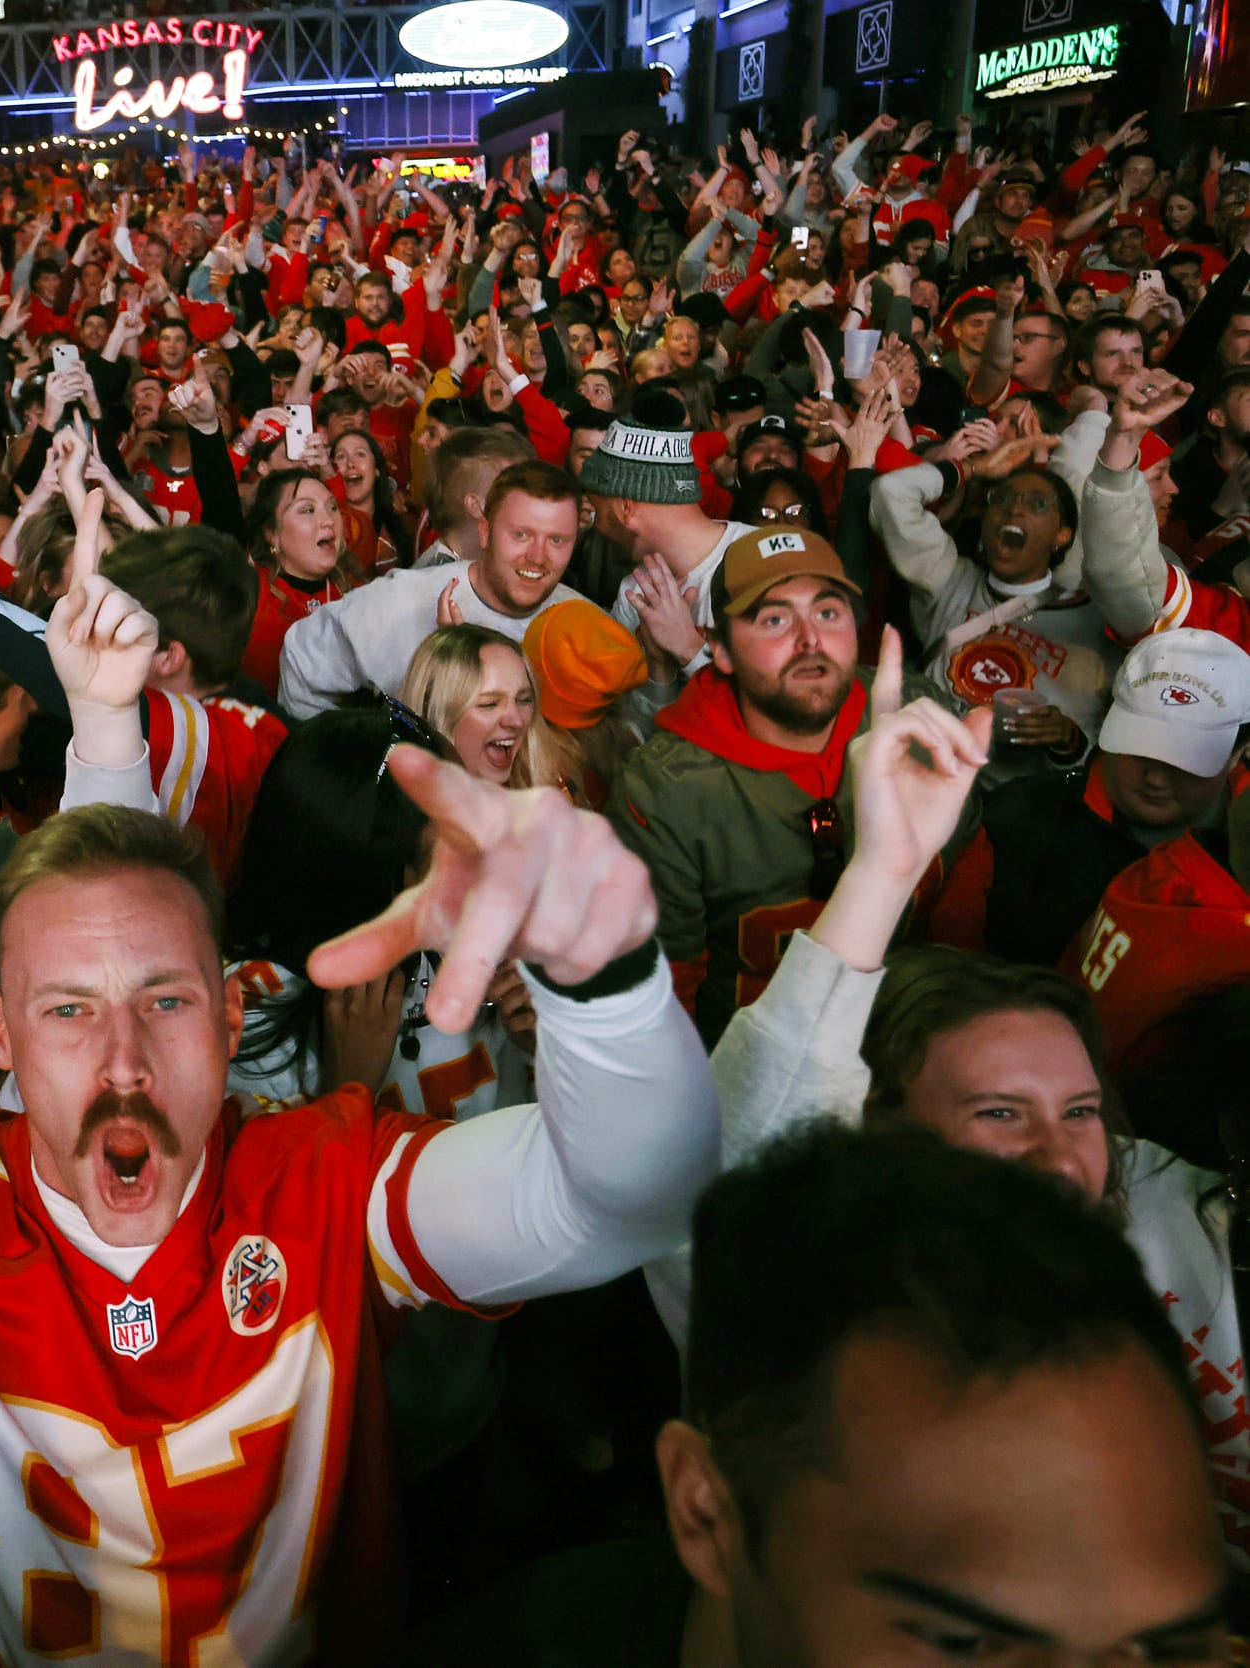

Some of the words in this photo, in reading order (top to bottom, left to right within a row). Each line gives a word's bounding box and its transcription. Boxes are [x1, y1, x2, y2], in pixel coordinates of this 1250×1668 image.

[52, 17, 184, 62] KANSAS
[192, 19, 263, 53] CITY
[74, 49, 246, 131] Live!
[395, 71, 463, 88] MIDWEST
[464, 70, 503, 85] FORD
[115, 1322, 152, 1349] NFL
